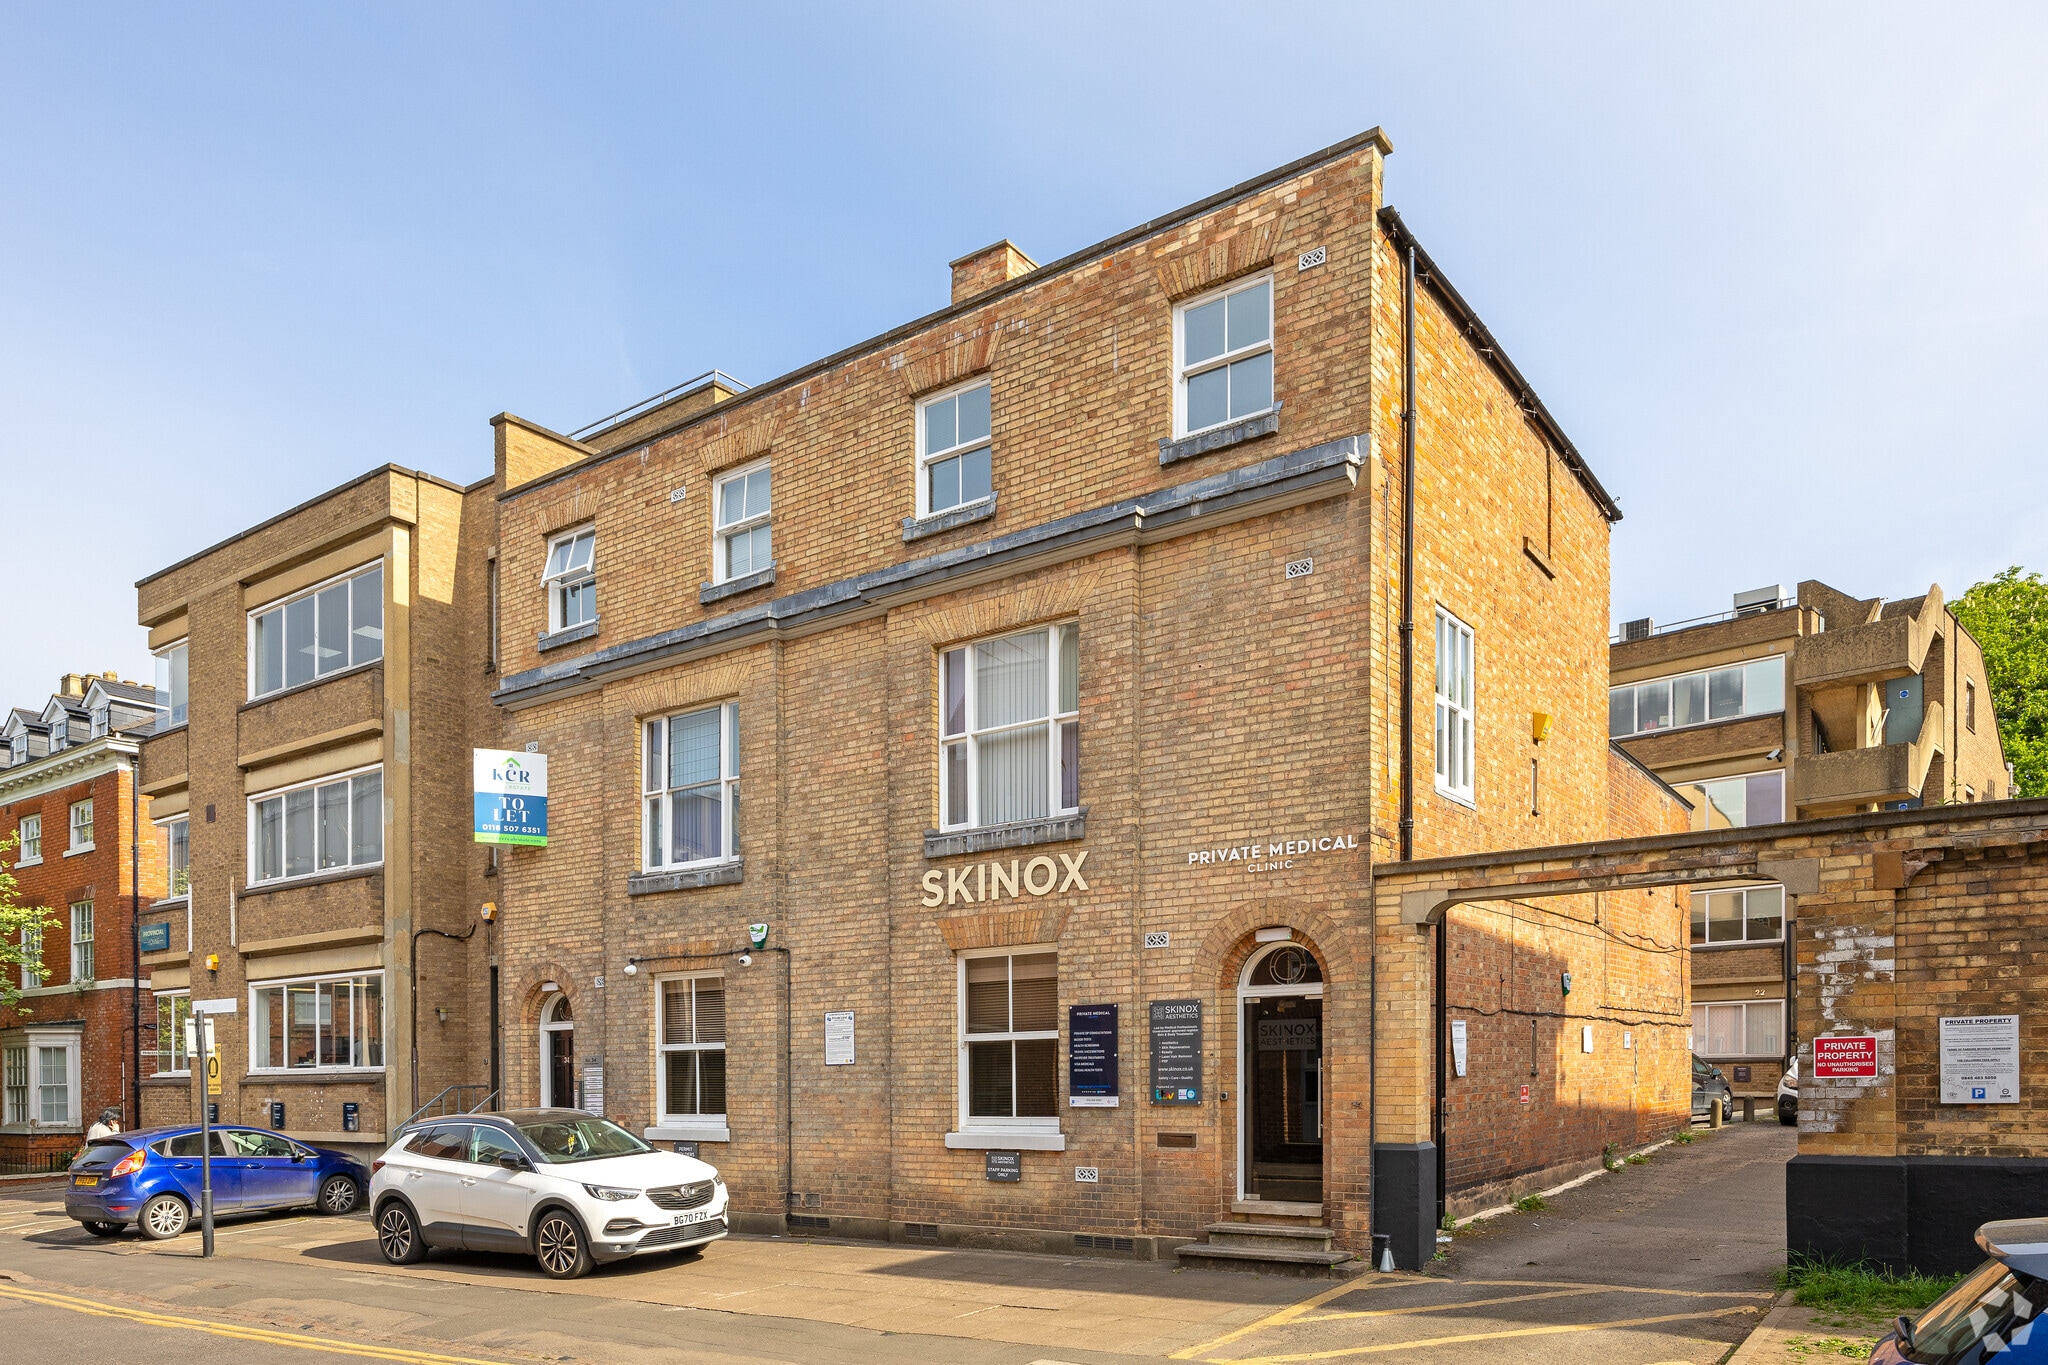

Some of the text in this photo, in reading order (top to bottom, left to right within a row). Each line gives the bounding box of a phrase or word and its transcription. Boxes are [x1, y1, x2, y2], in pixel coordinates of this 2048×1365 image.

[499, 796, 524, 810] TO
[493, 808, 530, 822] LET
[1188, 834, 1358, 865] PRIVATE MEDICAL
[1248, 860, 1293, 873] CLINIC
[921, 851, 1089, 907] SKINOX
[1165, 1005, 1198, 1013] SKINOX
[1260, 1024, 1315, 1036] SKINOX
[1261, 1037, 1315, 1046] AESTHETICS
[1824, 1042, 1866, 1050] PRIVATE
[674, 1211, 708, 1225] BG70 FZX
